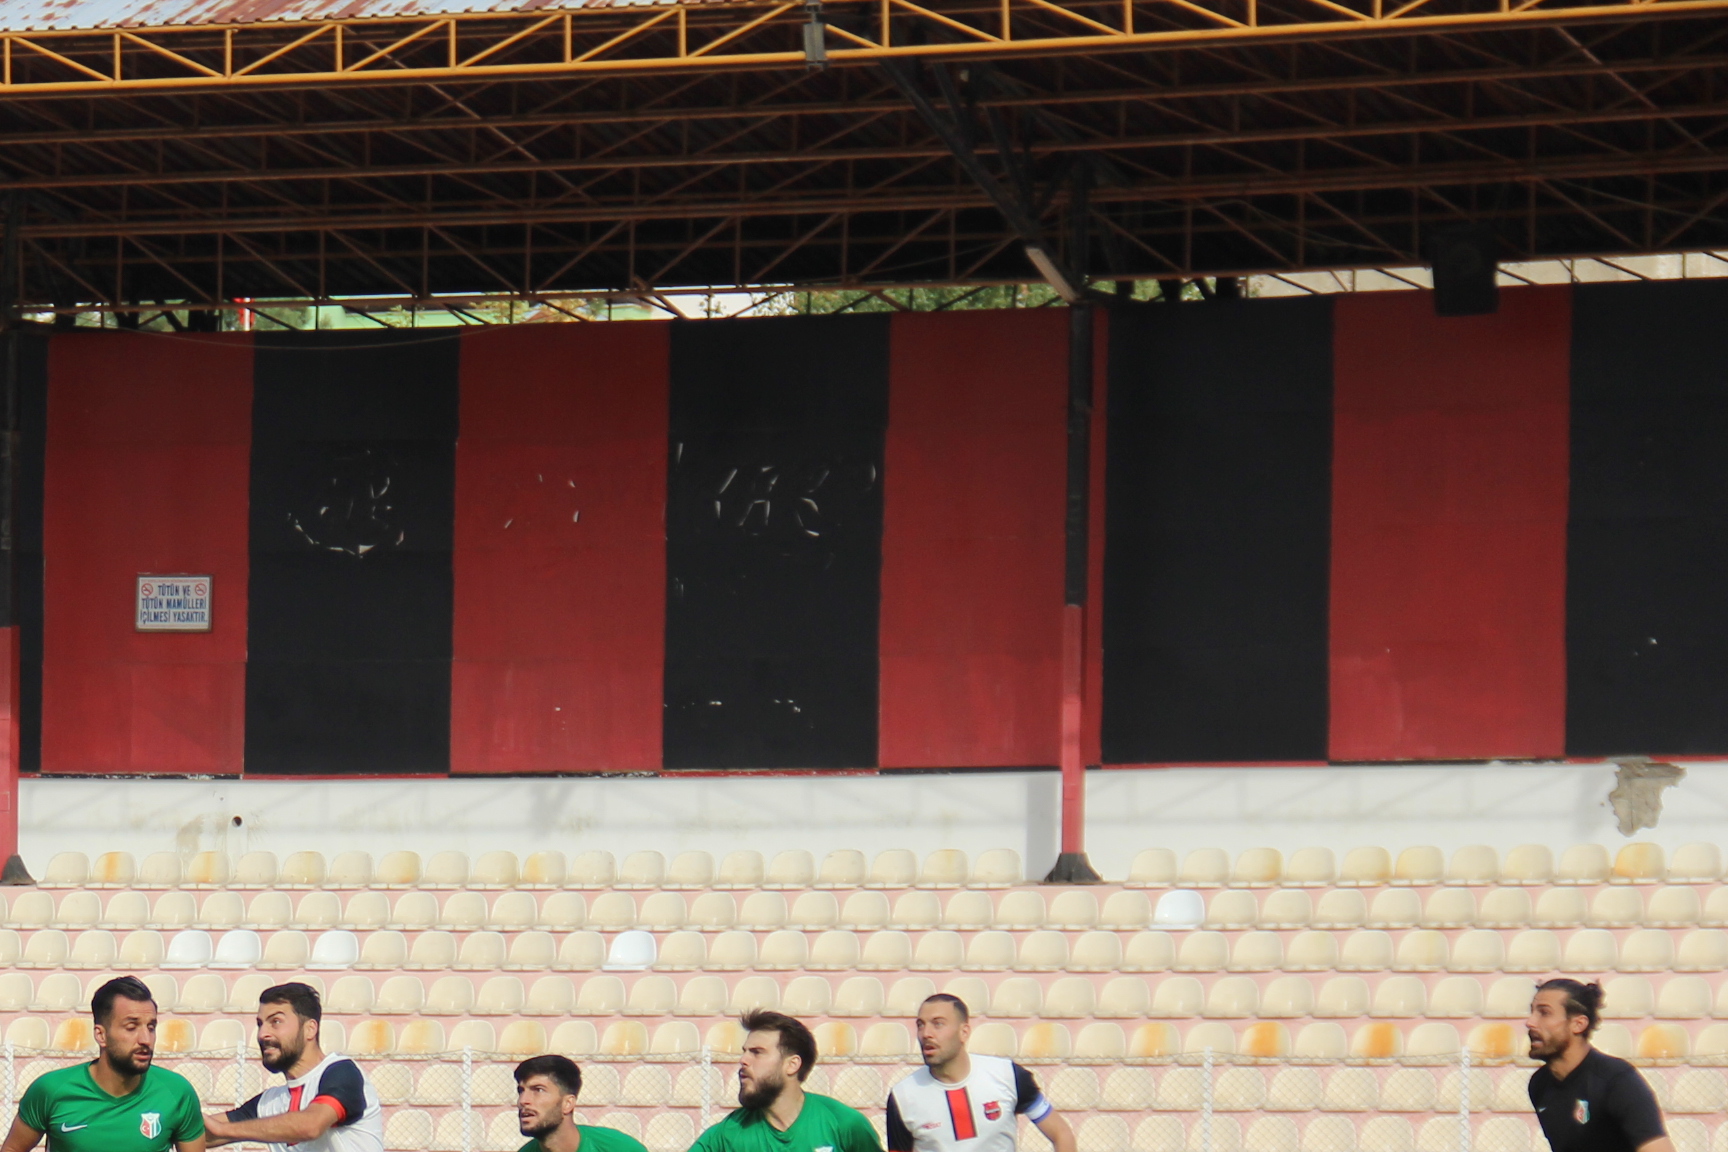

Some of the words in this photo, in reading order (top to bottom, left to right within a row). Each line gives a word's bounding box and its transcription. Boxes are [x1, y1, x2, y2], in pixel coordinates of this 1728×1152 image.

[158, 583, 180, 596] TÜTÜN
[183, 585, 191, 596] VE
[142, 596, 164, 609] TÜTÜN
